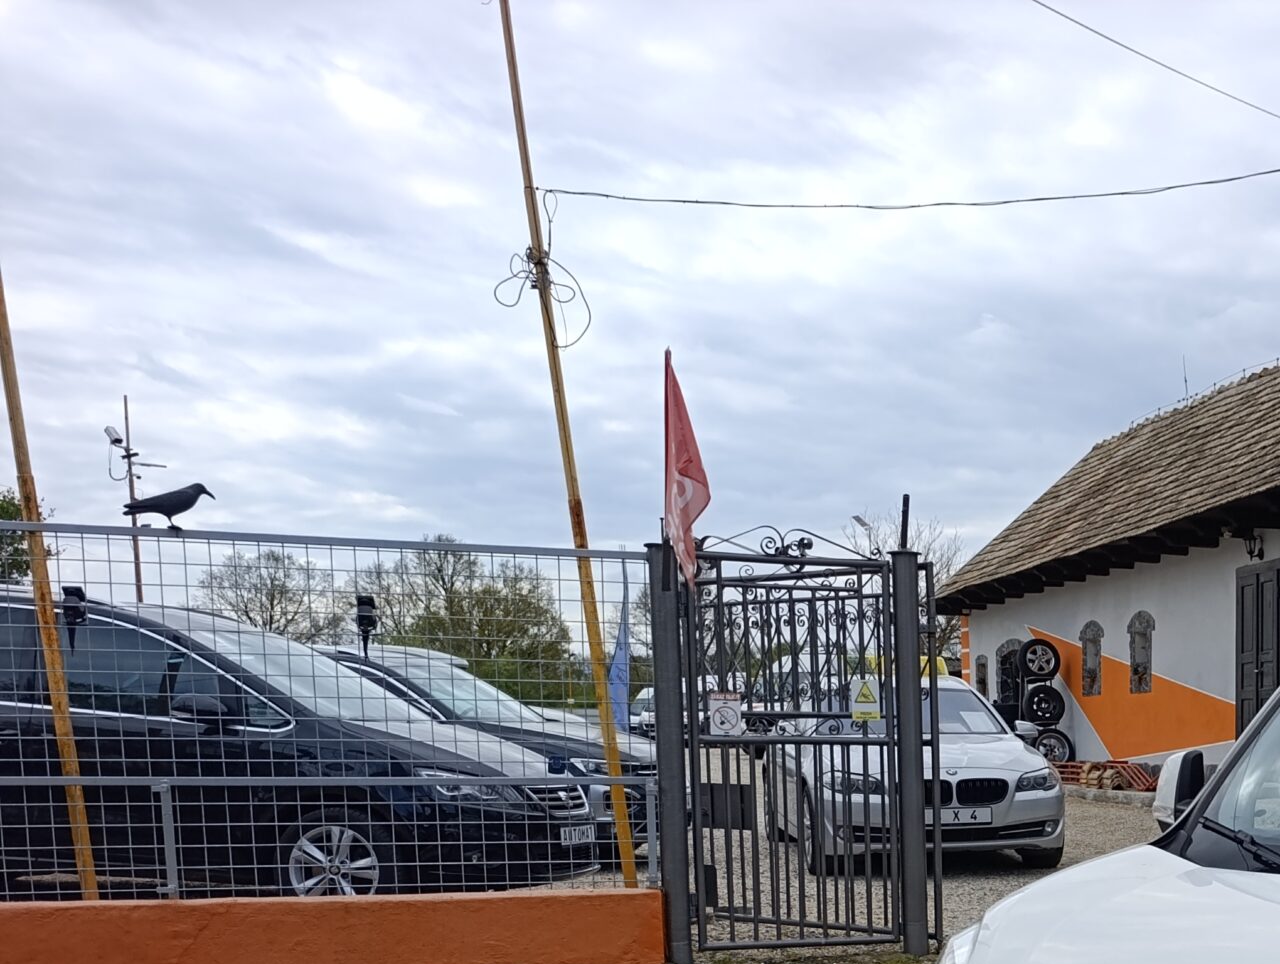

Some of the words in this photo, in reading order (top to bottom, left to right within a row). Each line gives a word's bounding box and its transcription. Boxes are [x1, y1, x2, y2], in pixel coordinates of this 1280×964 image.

[953, 810, 959, 822] X
[970, 810, 977, 821] 4
[563, 826, 594, 842] AUTOMAT
